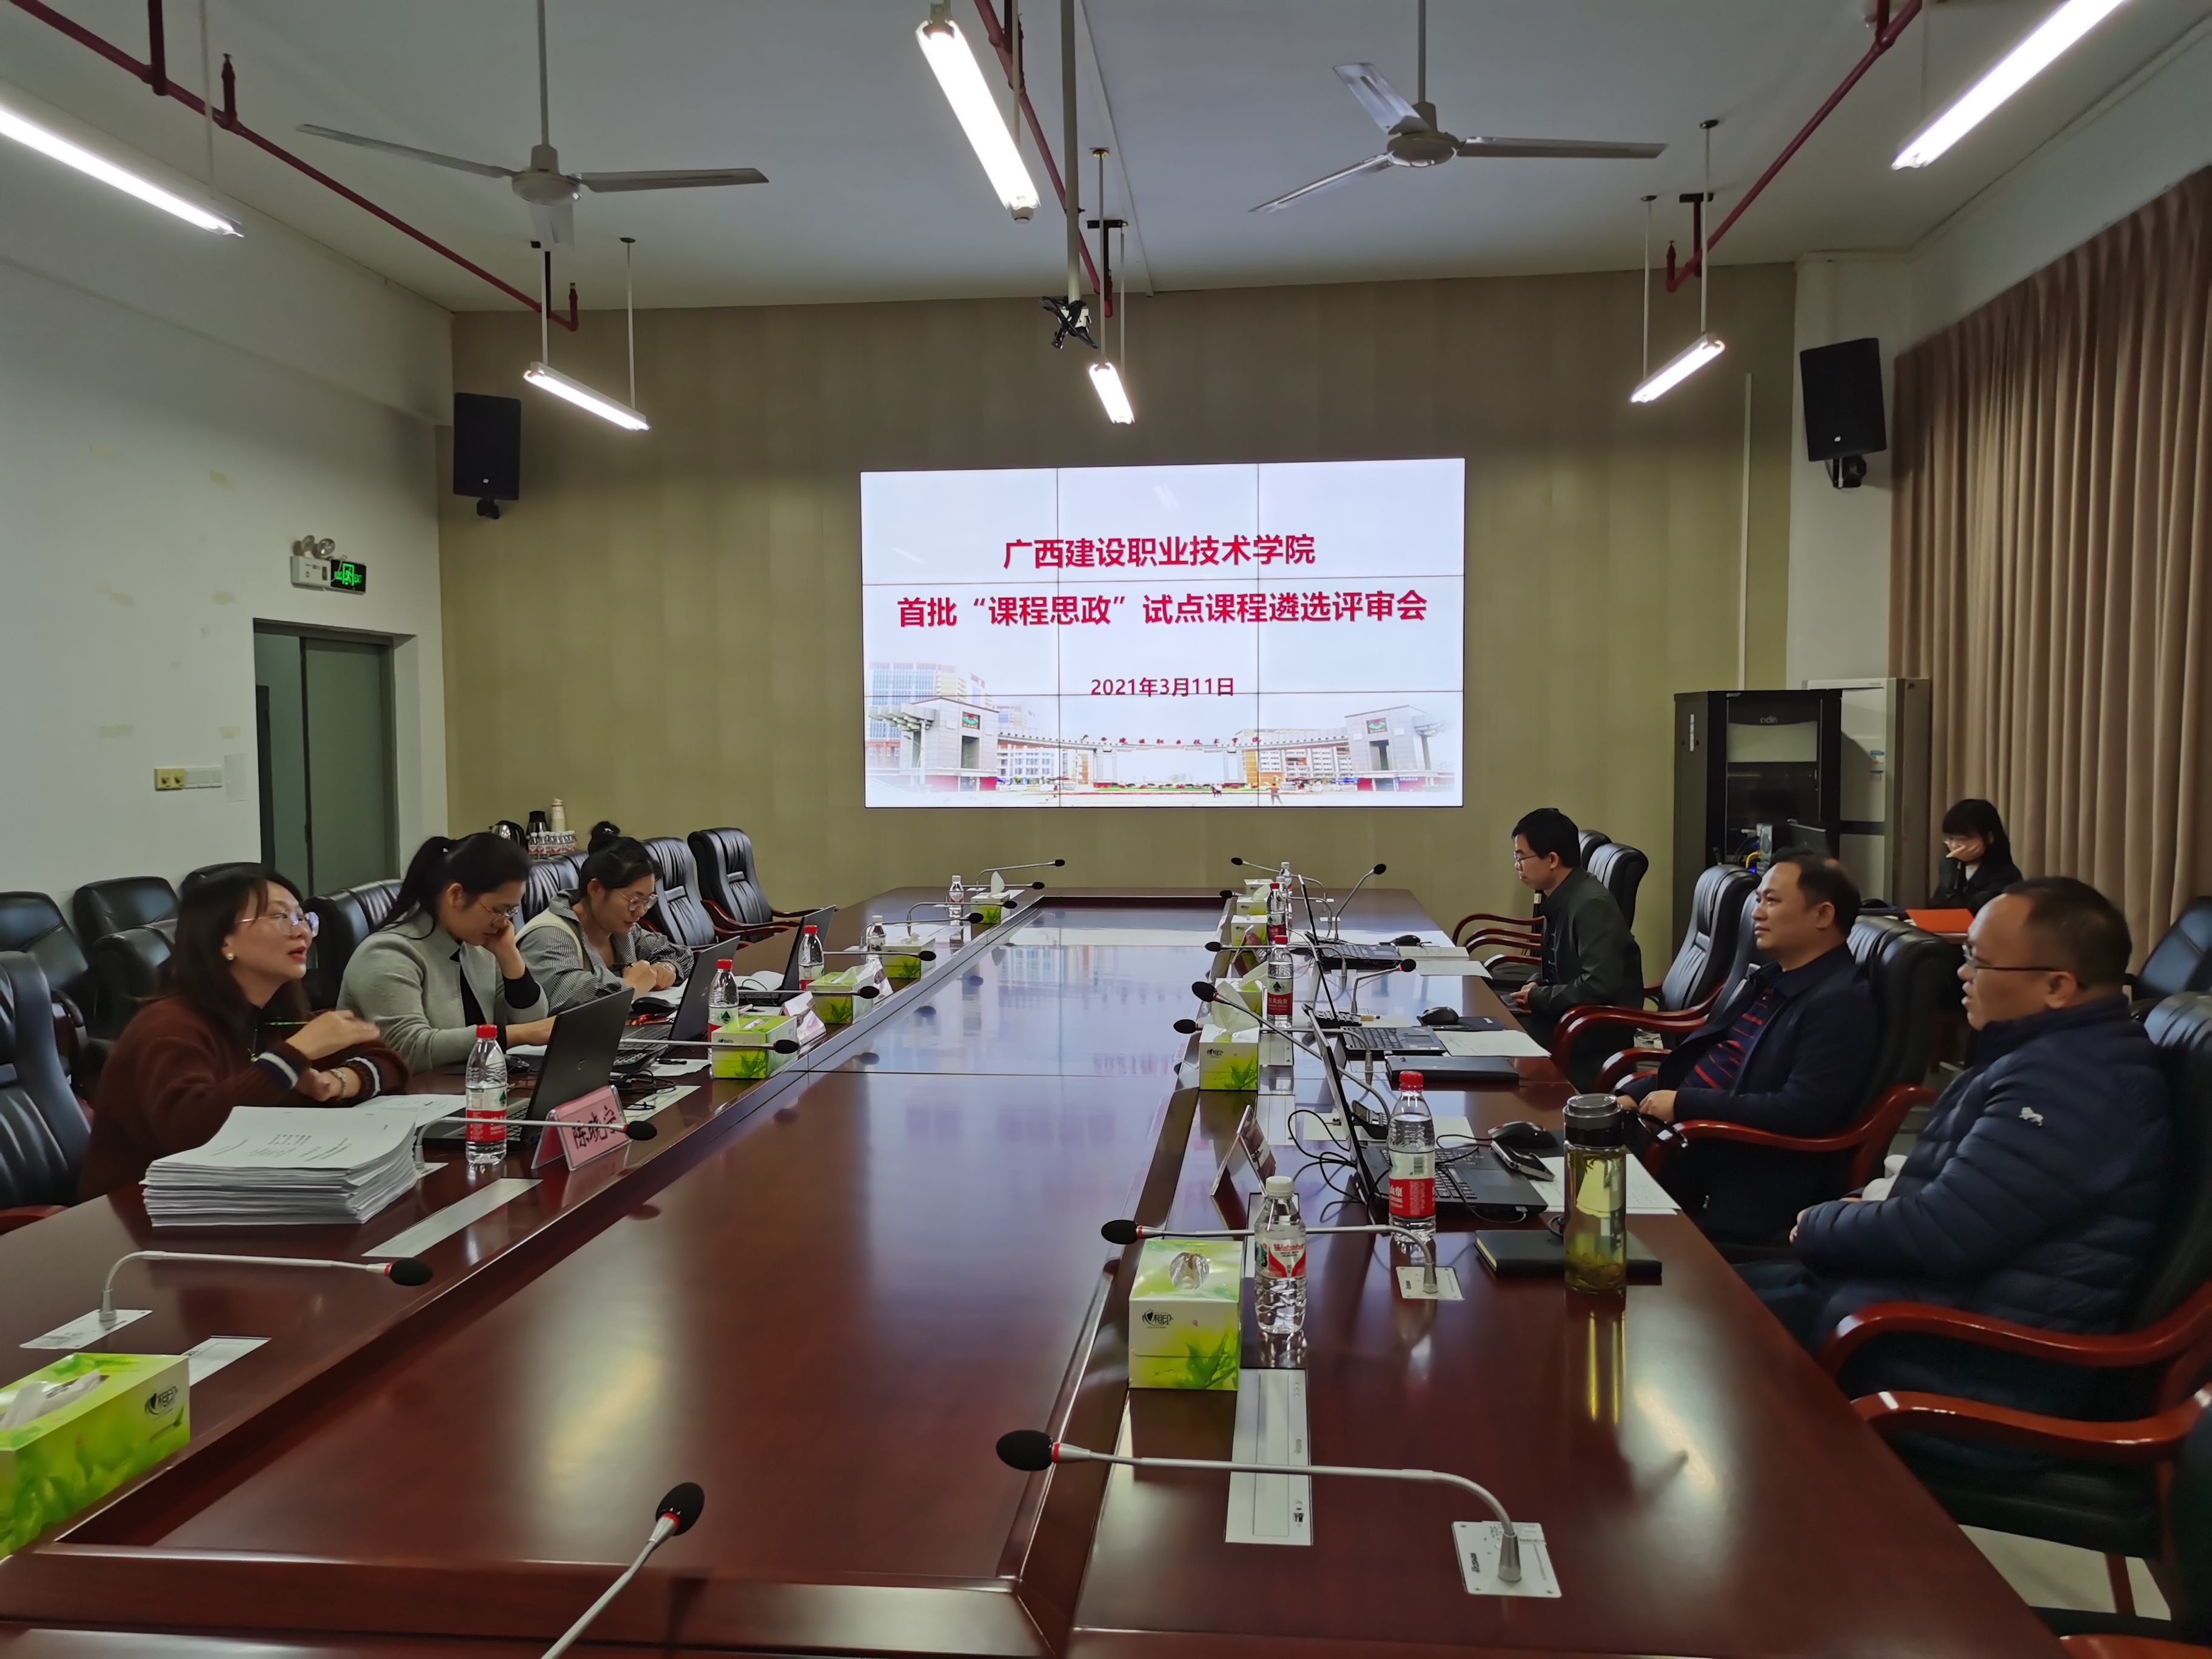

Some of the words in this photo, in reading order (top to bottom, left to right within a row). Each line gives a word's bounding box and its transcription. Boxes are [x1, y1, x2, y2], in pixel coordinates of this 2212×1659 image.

[1004, 534, 1315, 569] 广西建设职业技术学院
[1091, 677, 1234, 697] 2021年3月11日
